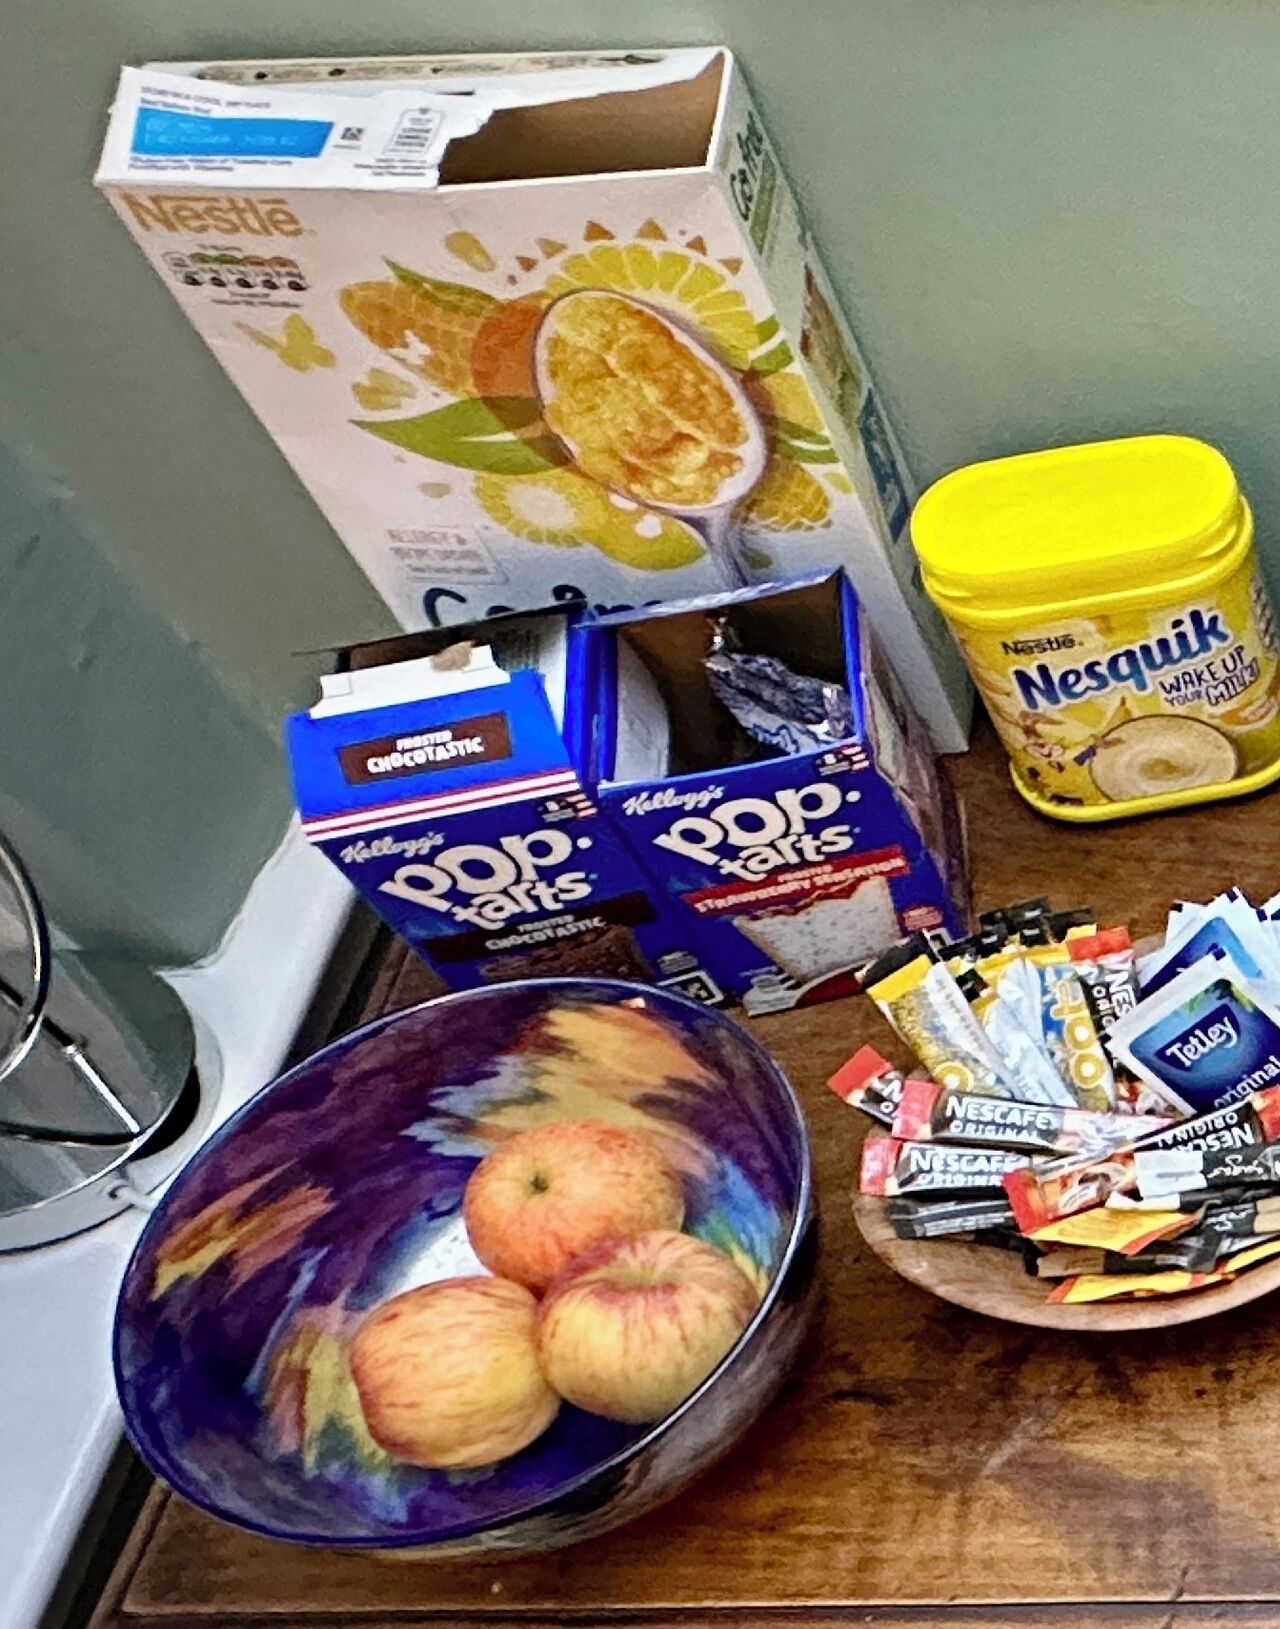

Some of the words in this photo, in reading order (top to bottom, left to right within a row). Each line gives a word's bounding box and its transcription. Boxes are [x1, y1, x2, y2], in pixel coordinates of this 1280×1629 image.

[1013, 608, 1231, 712] Nesquik
[1158, 661, 1220, 695] WAKE
[1220, 645, 1246, 680] UP
[367, 736, 484, 774] CHOCOTASTIC
[622, 785, 726, 815] Kellogg's
[341, 831, 446, 864] Kellogg's
[1165, 1015, 1238, 1068] Tetley
